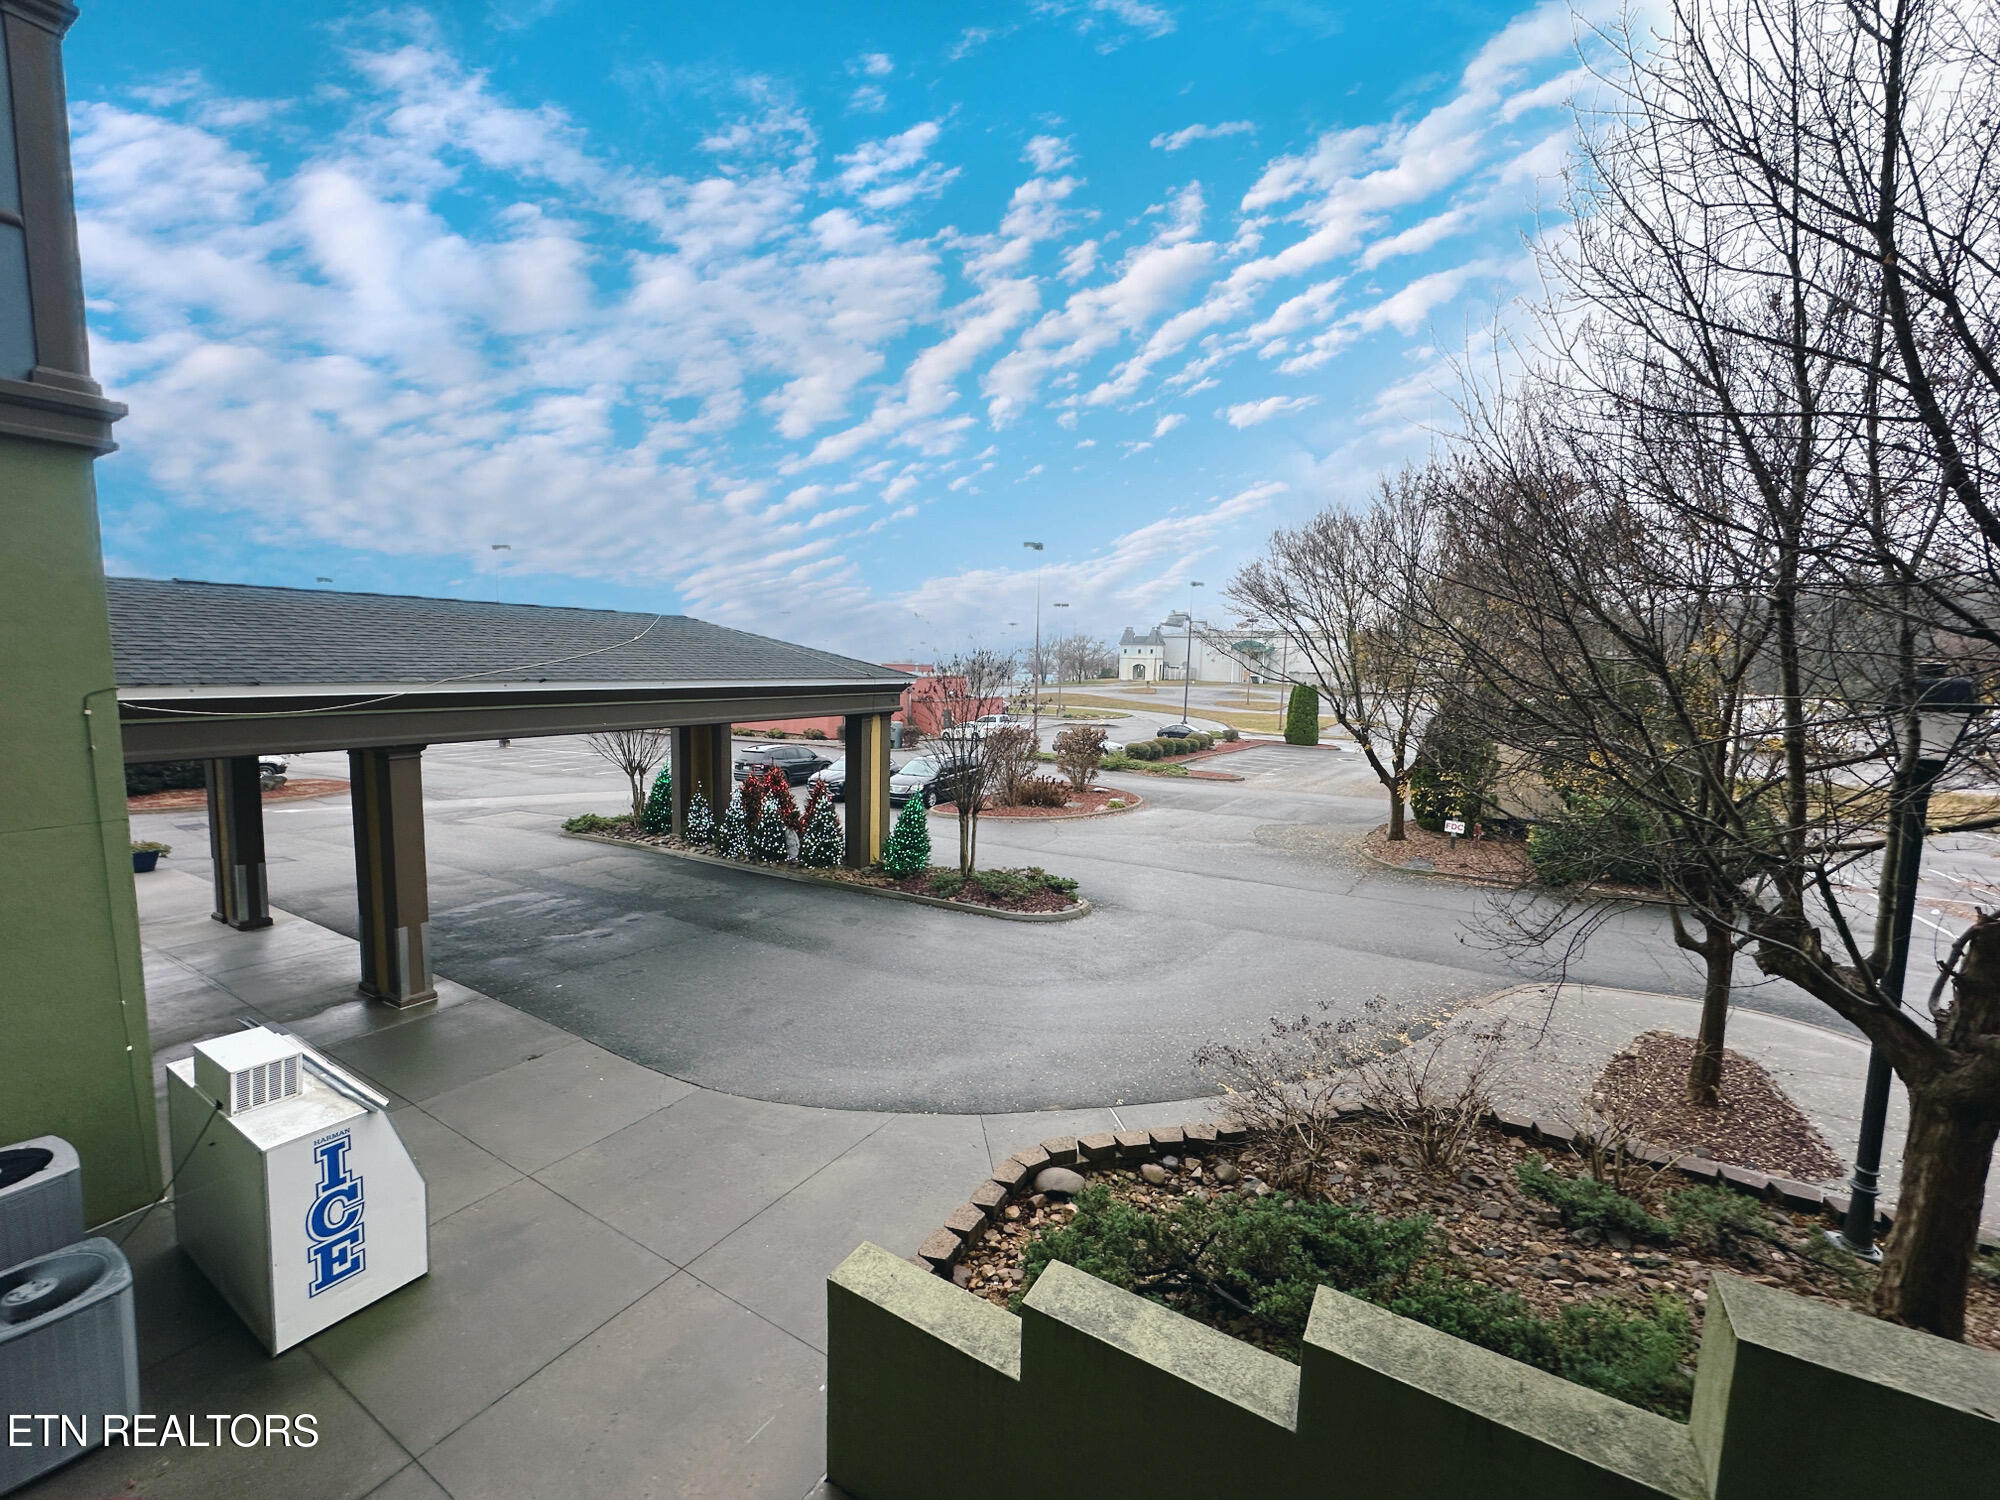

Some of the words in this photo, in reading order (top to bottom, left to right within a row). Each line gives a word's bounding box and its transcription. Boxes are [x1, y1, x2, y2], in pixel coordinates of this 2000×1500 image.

[1446, 822, 1464, 831] FDC
[313, 1127, 351, 1146] HARMAN
[306, 1135, 366, 1298] ICE
